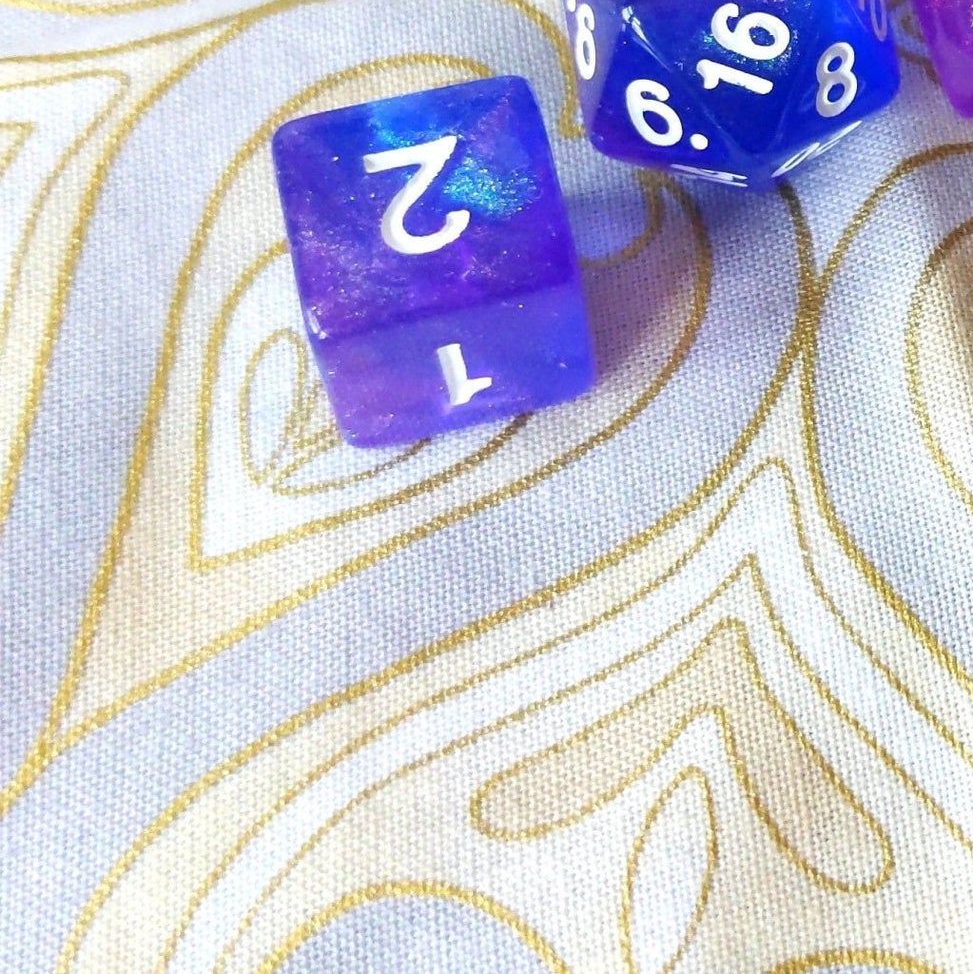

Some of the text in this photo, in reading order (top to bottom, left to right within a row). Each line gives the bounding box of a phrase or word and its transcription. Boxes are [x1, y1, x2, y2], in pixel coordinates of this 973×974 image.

[696, 3, 790, 95] 16
[816, 42, 857, 117] 8
[362, 135, 470, 255] 2
[437, 343, 492, 406] 1
